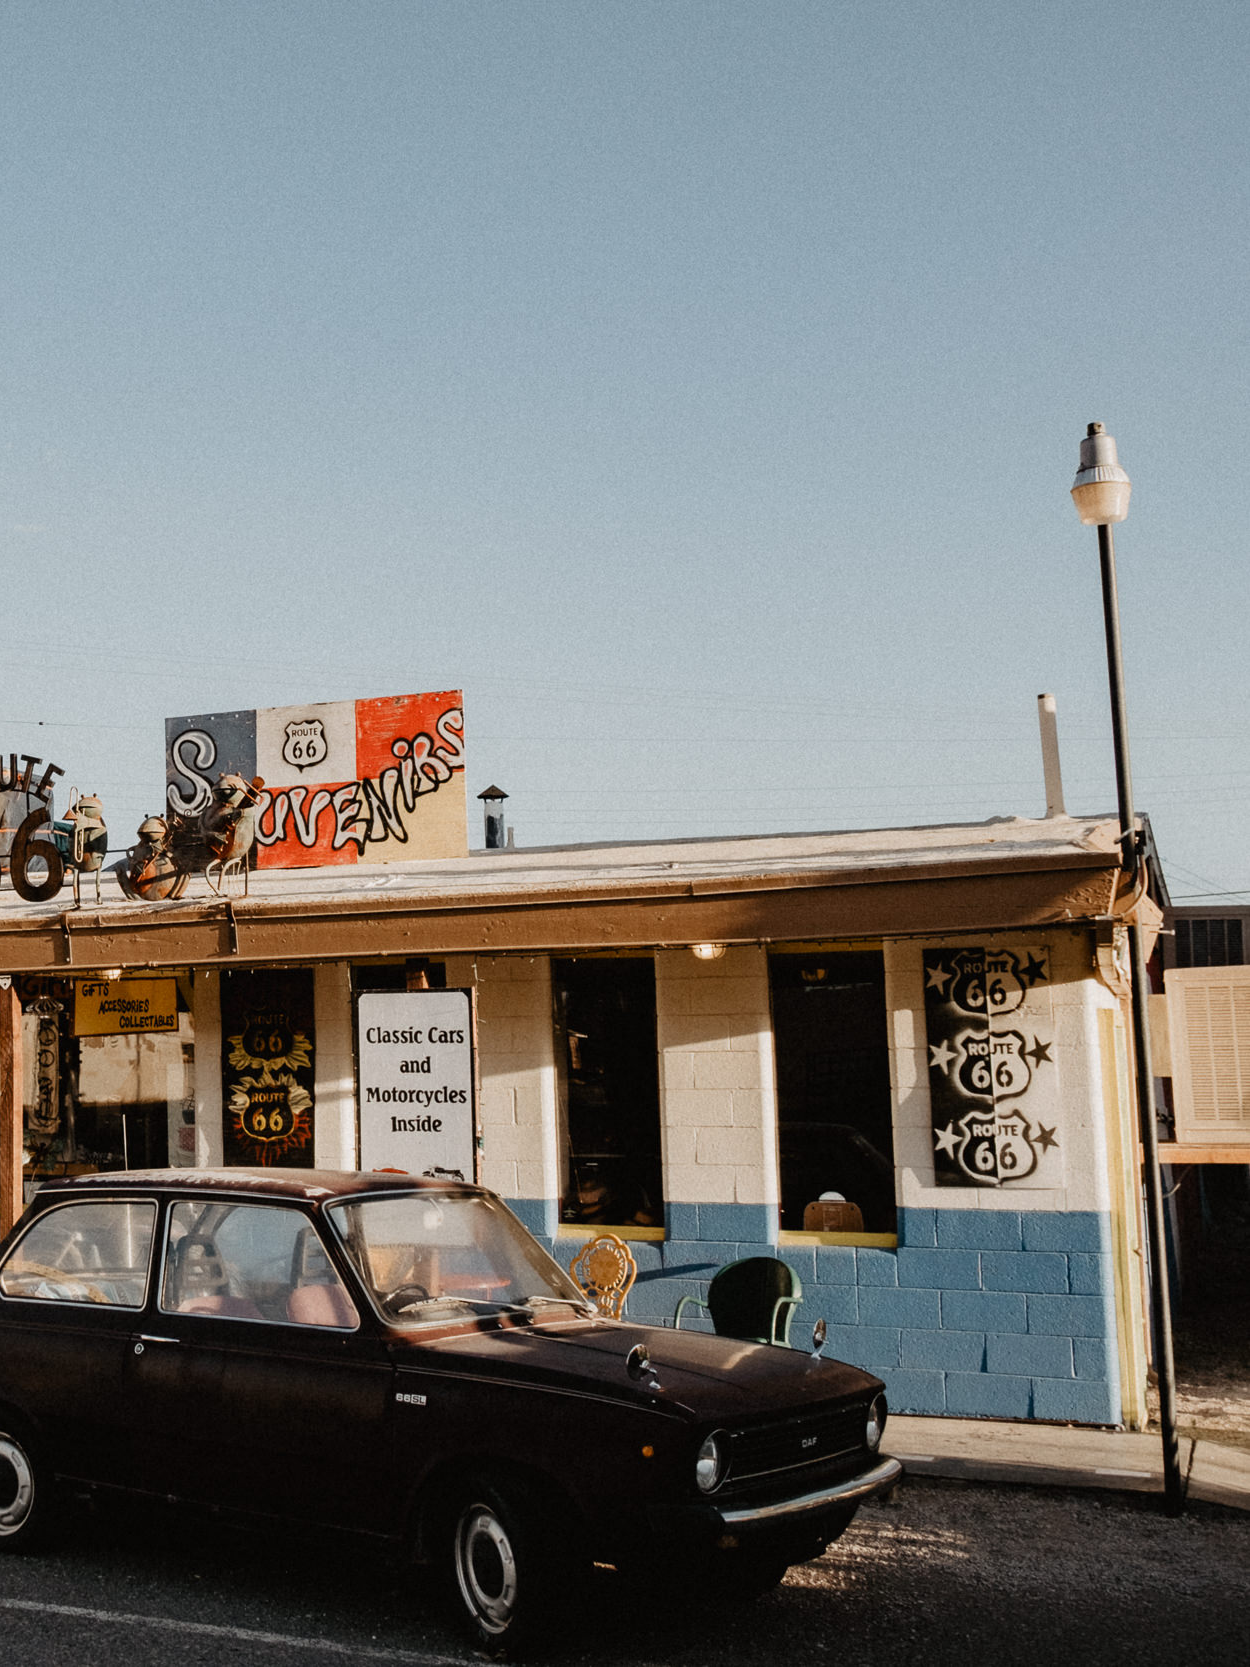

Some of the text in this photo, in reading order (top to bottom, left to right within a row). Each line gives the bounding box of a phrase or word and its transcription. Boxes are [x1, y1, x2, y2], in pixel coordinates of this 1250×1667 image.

[291, 727, 318, 738] ROUTE
[292, 740, 317, 759] 66
[963, 959, 1009, 974] ROUTE
[966, 978, 1007, 1007] 66
[119, 1014, 175, 1029] COLLECTABLES
[251, 1014, 284, 1025] ROUTE
[254, 1029, 283, 1052] 66
[366, 1026, 464, 1044] Classic Cars
[968, 1043, 1013, 1056] ROUTE
[400, 1056, 431, 1073] and
[971, 1060, 1013, 1089] 66
[251, 1092, 284, 1103] ROUTE
[366, 1086, 467, 1107] Motorcycles
[252, 1107, 284, 1132] 66
[391, 1115, 442, 1132] Inside
[972, 1124, 1019, 1137] ROUTE
[974, 1141, 1018, 1171] 66
[801, 1436, 818, 1448] DAF
